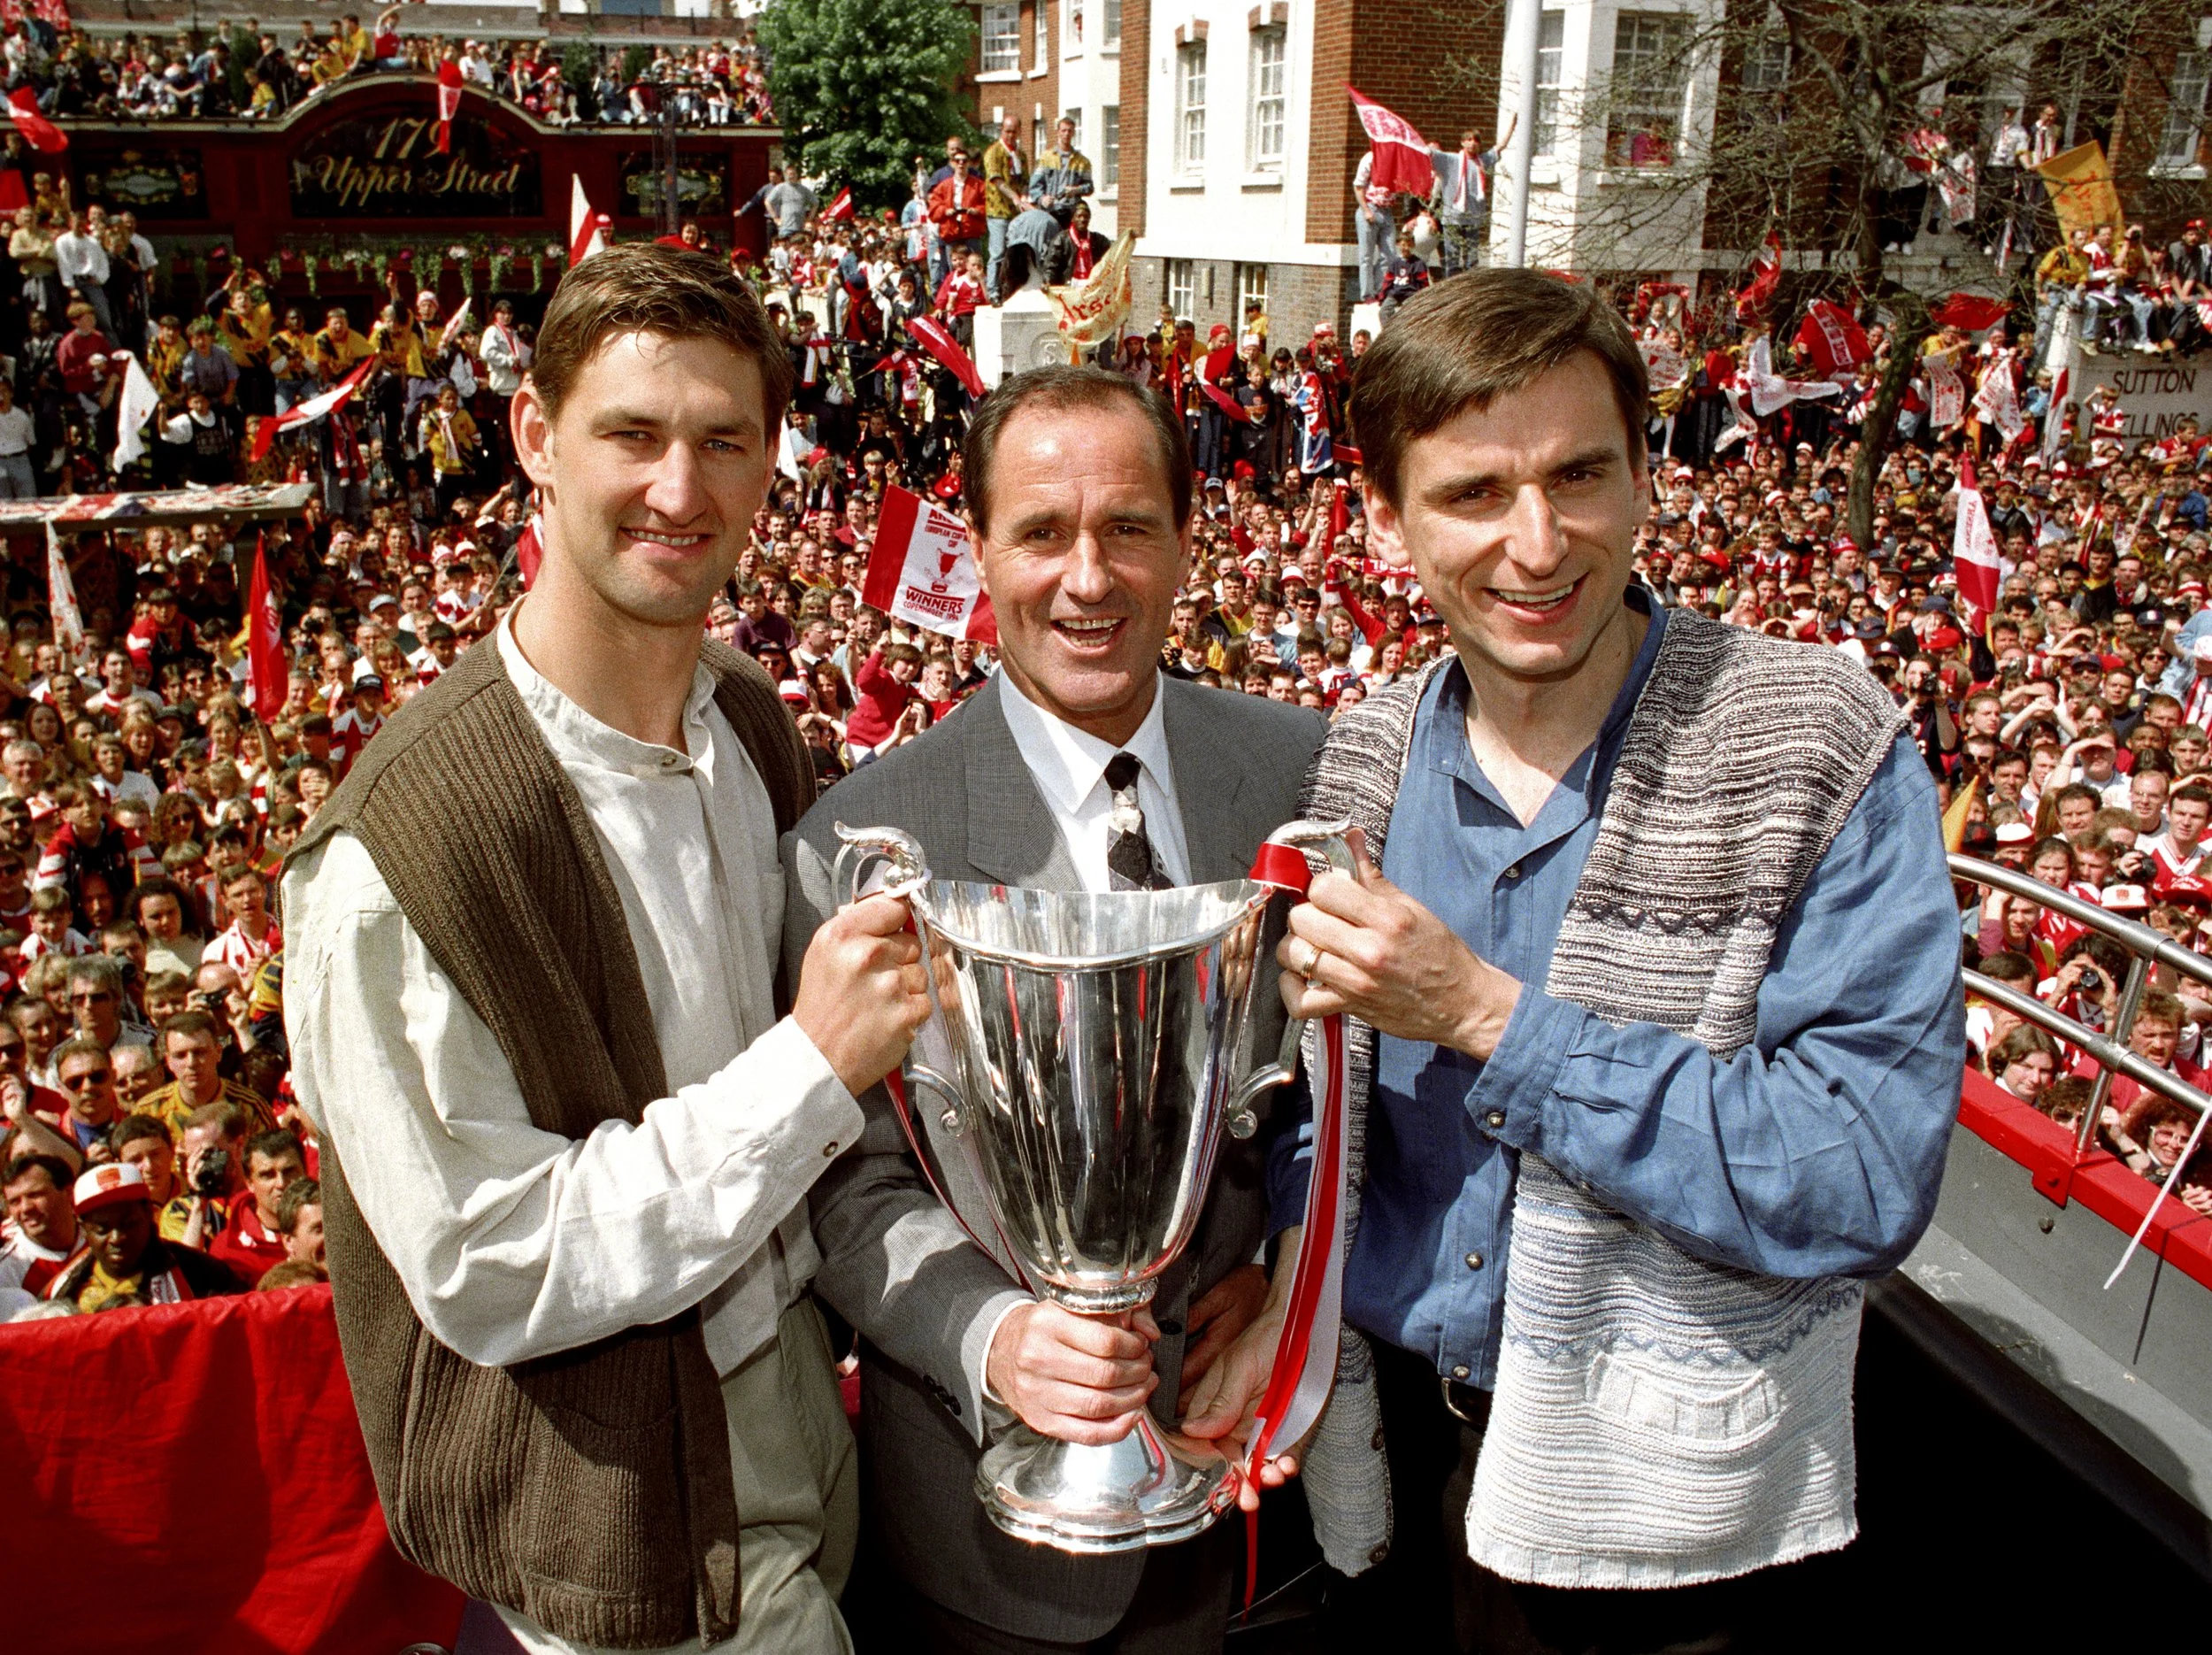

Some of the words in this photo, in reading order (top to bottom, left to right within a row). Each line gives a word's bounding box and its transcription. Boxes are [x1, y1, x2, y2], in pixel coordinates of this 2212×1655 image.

[310, 154, 413, 207] Upper
[425, 152, 520, 196] Street
[2113, 368, 2197, 395] SUTTON
[2088, 412, 2200, 439] ELLIN
[903, 601, 944, 618] COPENHAGEN
[906, 589, 963, 614] WINNERS
